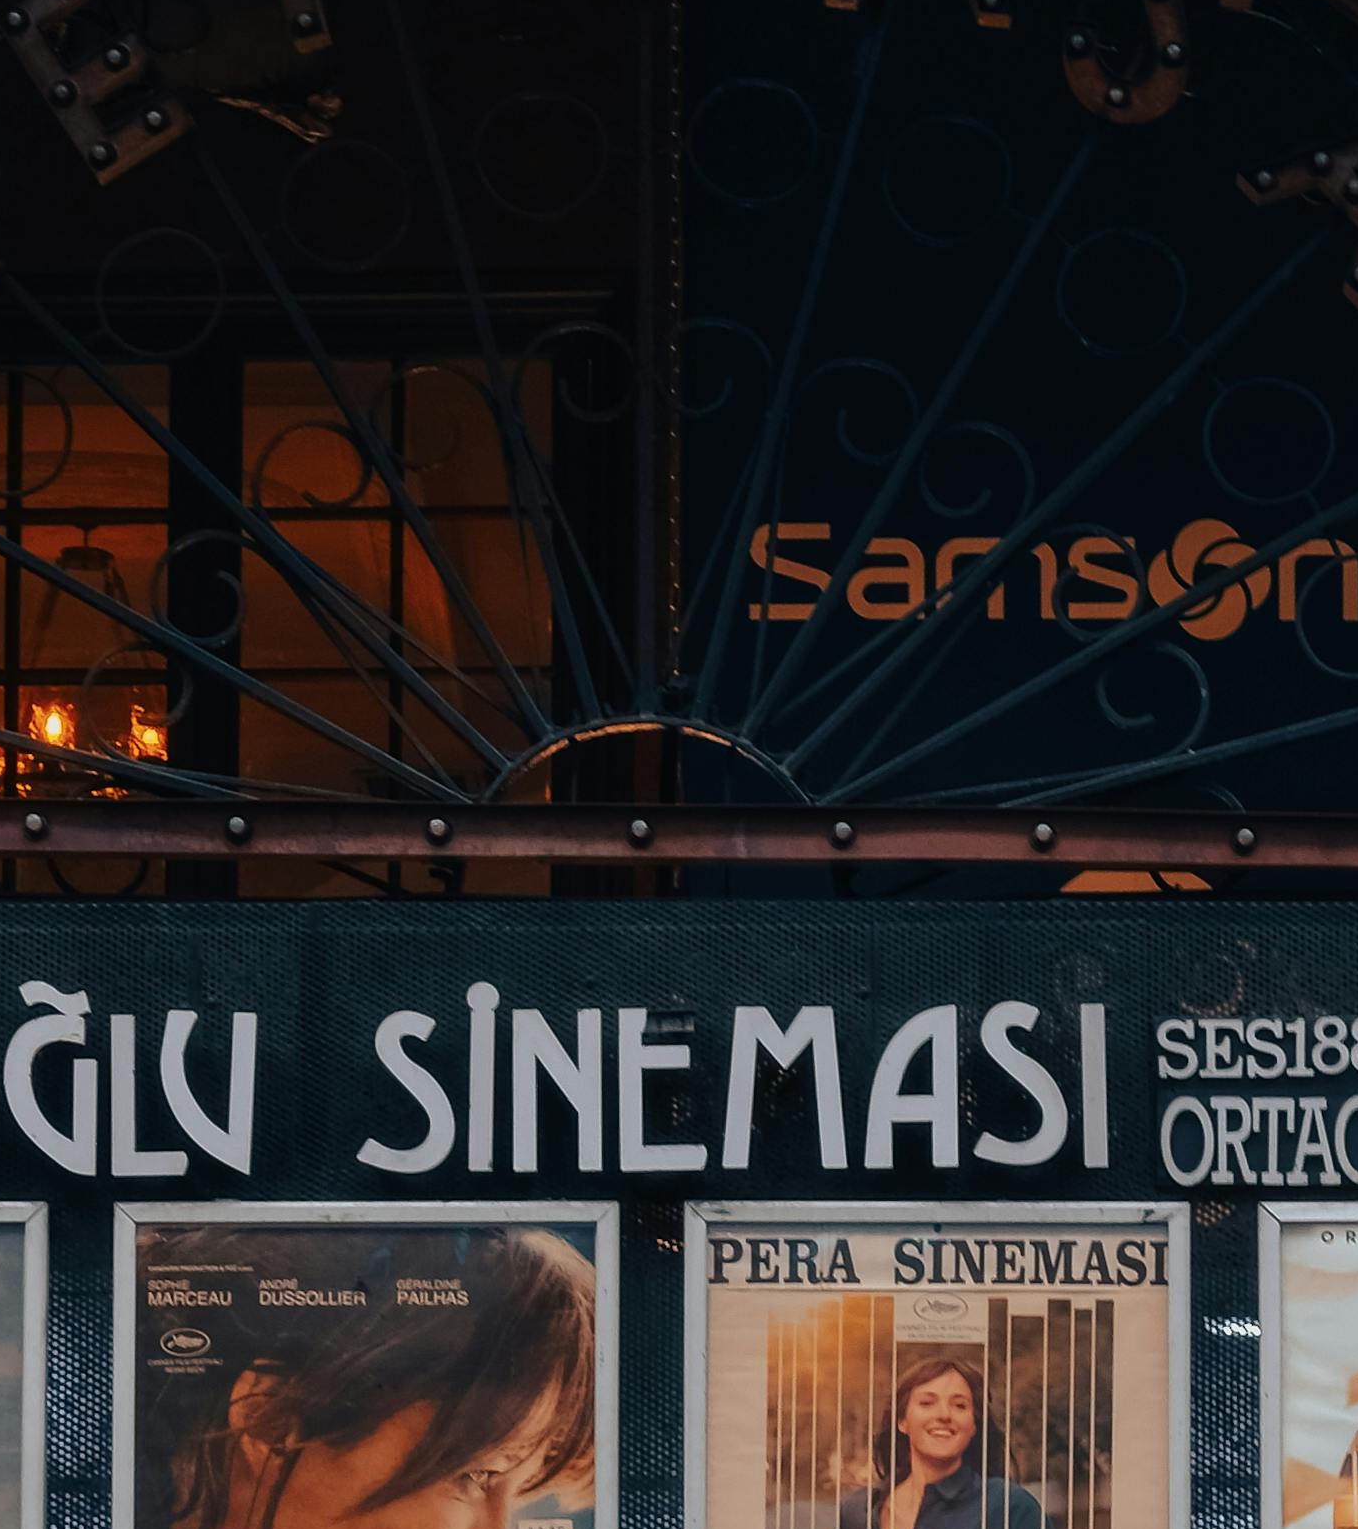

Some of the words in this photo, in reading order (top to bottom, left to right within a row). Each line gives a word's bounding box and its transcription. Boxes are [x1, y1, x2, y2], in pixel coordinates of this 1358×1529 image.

[355, 980, 1110, 1174] SİNEMASI
[708, 1238, 861, 1285] PERA
[894, 1237, 1168, 1287] SINEMASI
[147, 1290, 233, 1307] MARCEAU
[258, 1290, 367, 1307] DUSSOLLIER
[396, 1290, 470, 1307] PAILHAS
